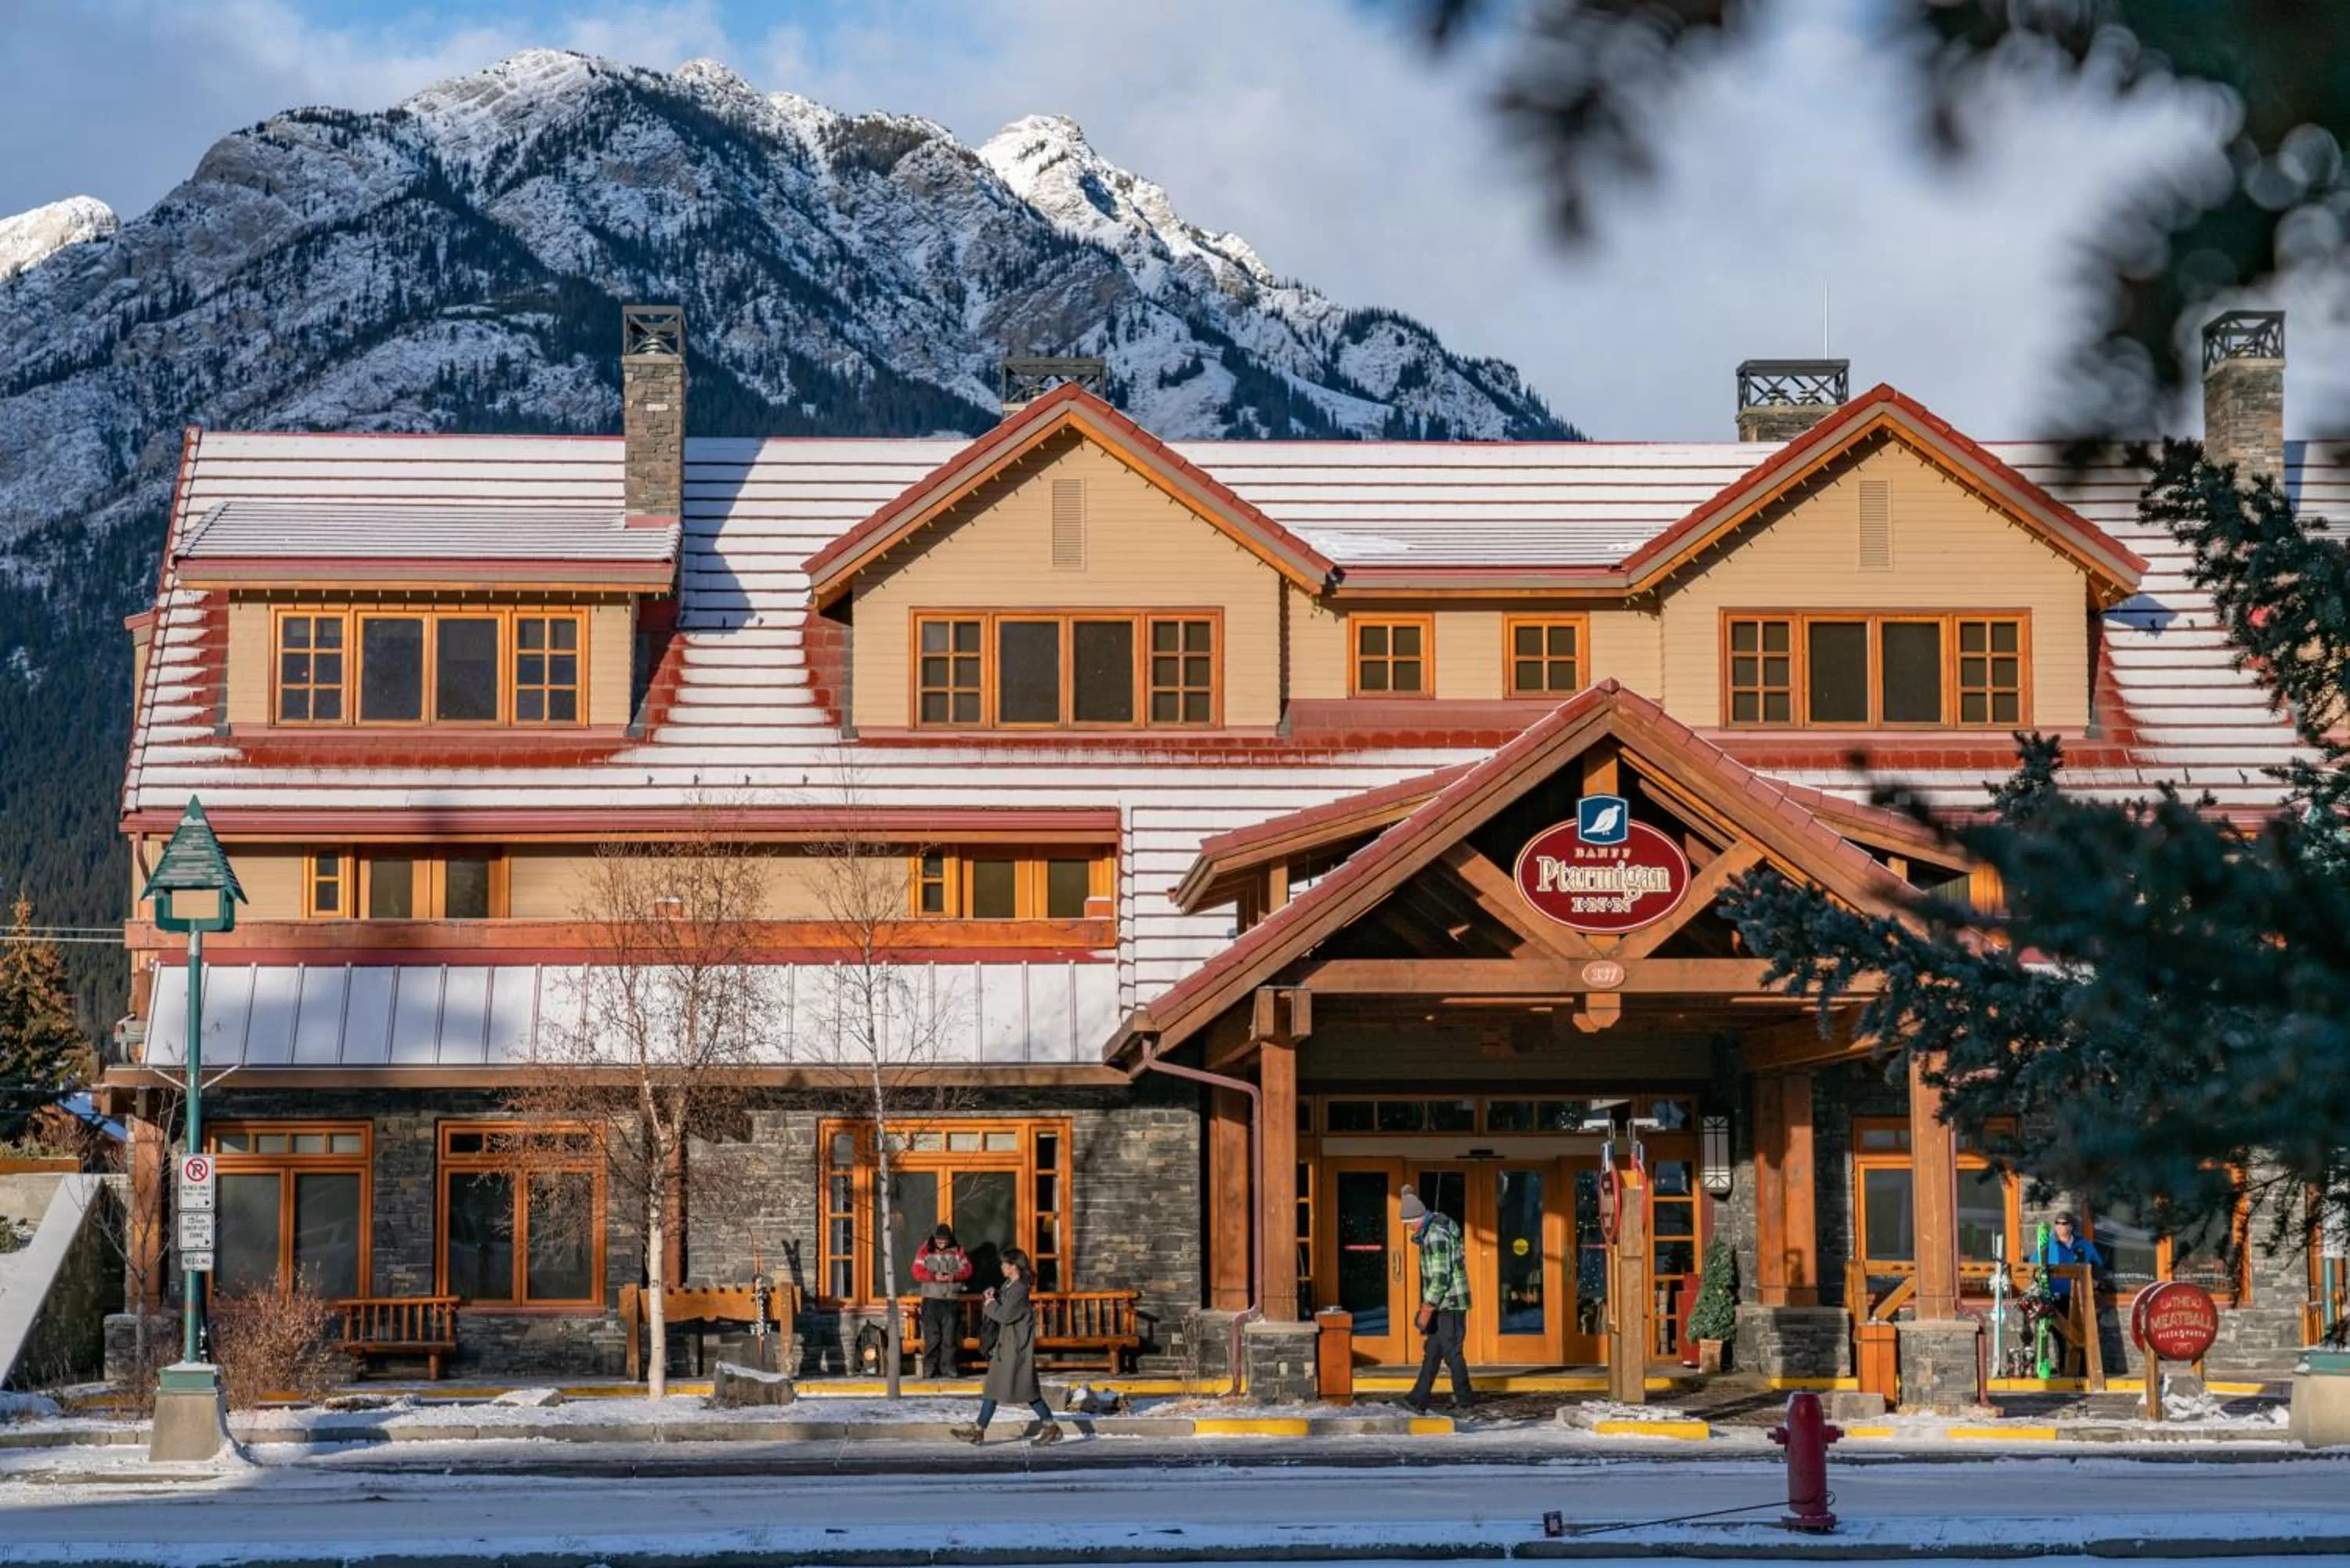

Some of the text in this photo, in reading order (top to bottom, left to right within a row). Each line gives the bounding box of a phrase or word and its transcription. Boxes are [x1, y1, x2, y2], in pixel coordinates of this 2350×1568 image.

[1574, 847, 1631, 858] BANFF
[1536, 856, 1671, 900] Ptarmigan
[2171, 1296, 2191, 1308] THE
[2150, 1310, 2214, 1334] MEATBALL
